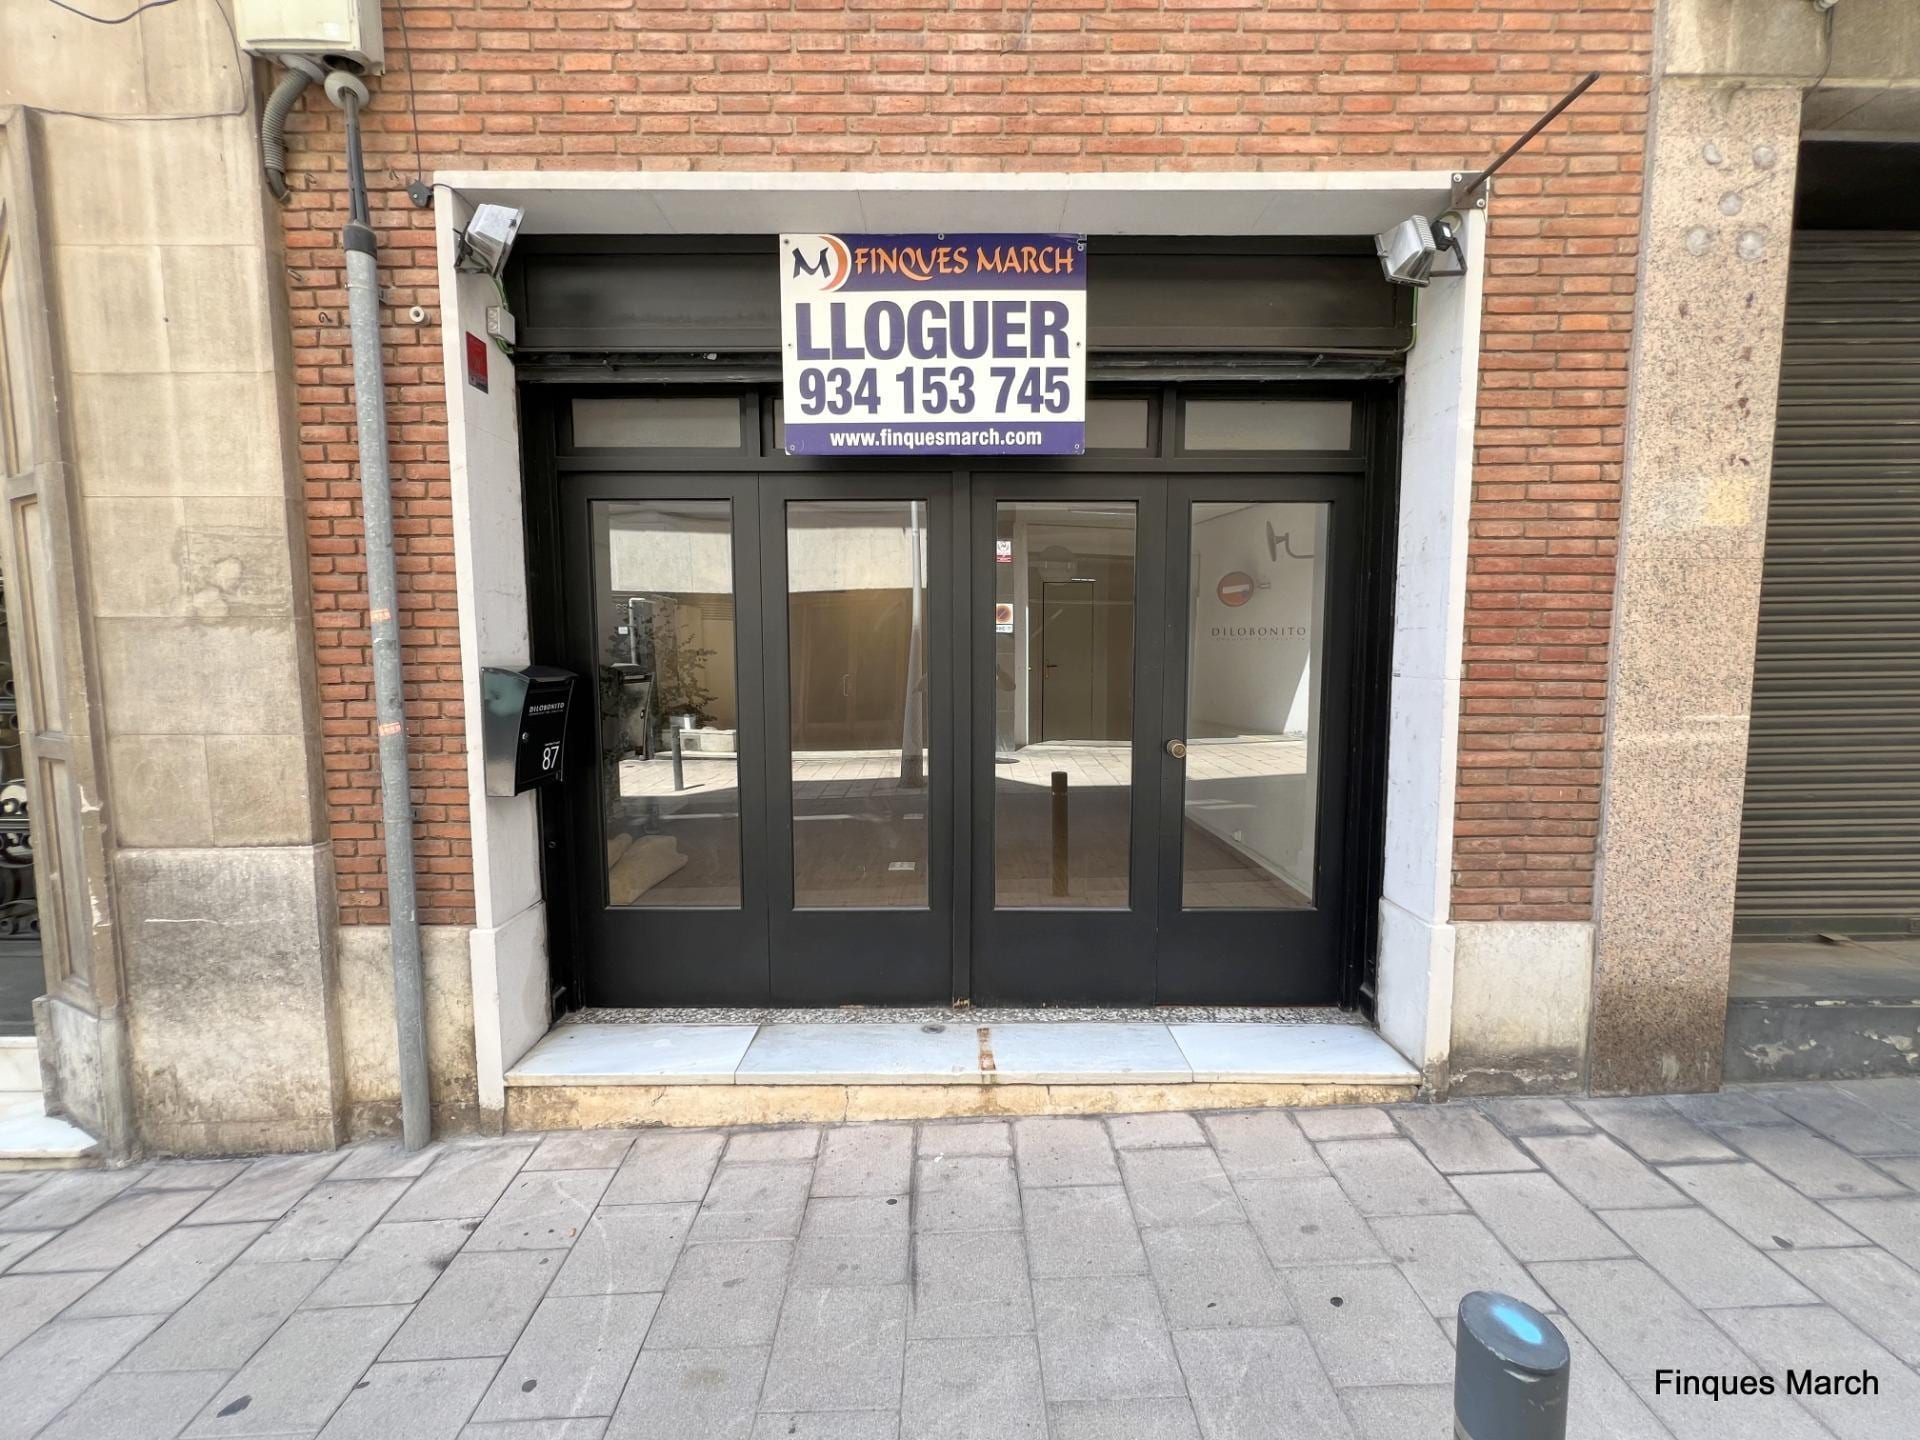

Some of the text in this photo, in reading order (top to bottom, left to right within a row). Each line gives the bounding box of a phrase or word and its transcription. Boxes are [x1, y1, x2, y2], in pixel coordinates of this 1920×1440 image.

[854, 246, 1074, 281] FINQUES MARCH
[796, 300, 1070, 360] LLOGUER
[799, 366, 1070, 415] 934 153 745
[830, 428, 1042, 449] www.finquesmarch.com
[1211, 626, 1306, 637] DILOBONITO
[542, 745, 560, 770] 87
